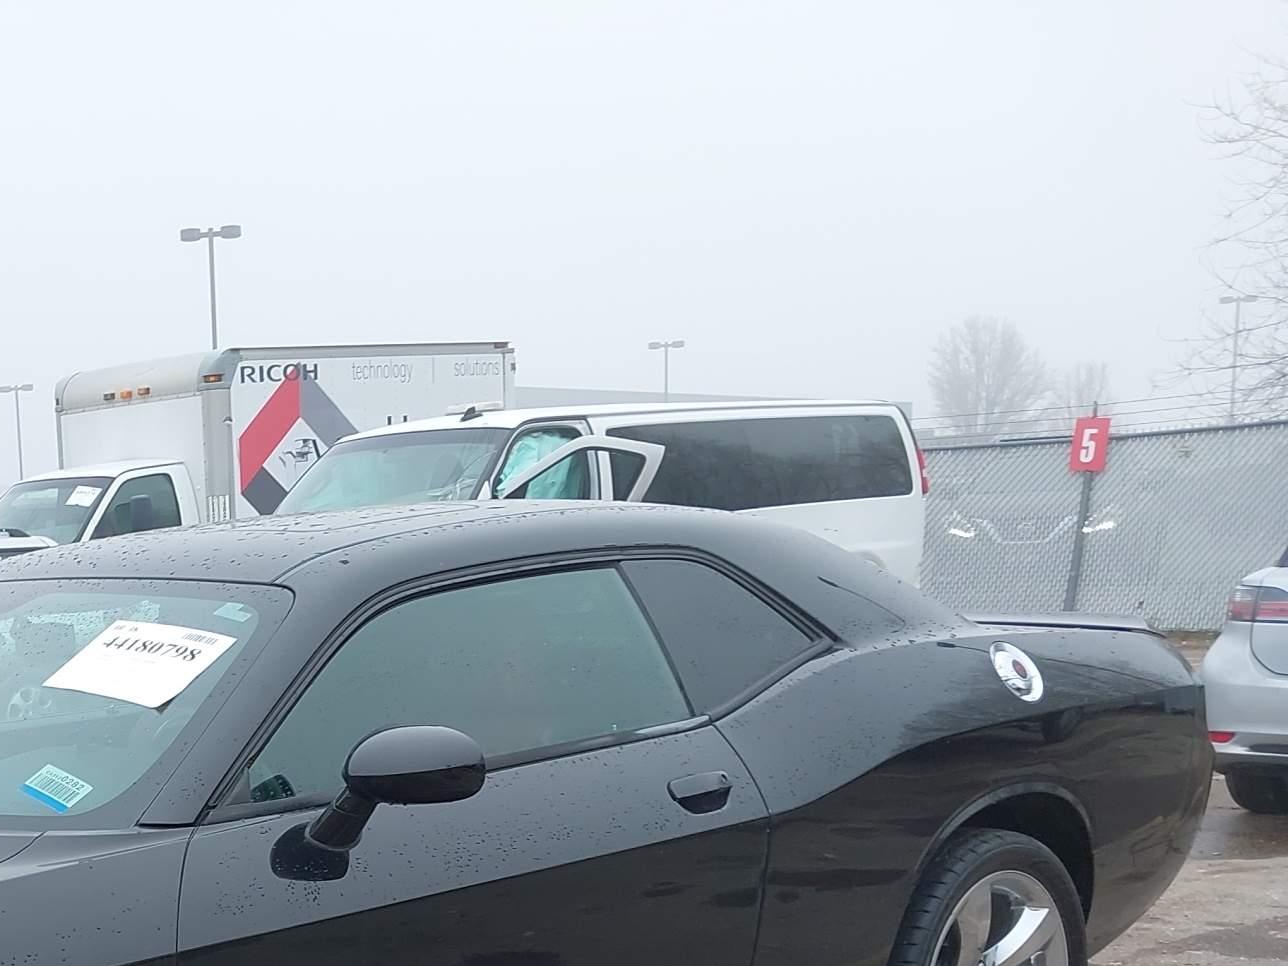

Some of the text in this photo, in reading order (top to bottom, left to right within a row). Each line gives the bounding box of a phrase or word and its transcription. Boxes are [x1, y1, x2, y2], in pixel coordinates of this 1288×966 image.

[240, 359, 499, 384] RICOH technology solutions
[1080, 429, 1099, 463] 5
[103, 636, 202, 662] 44180798
